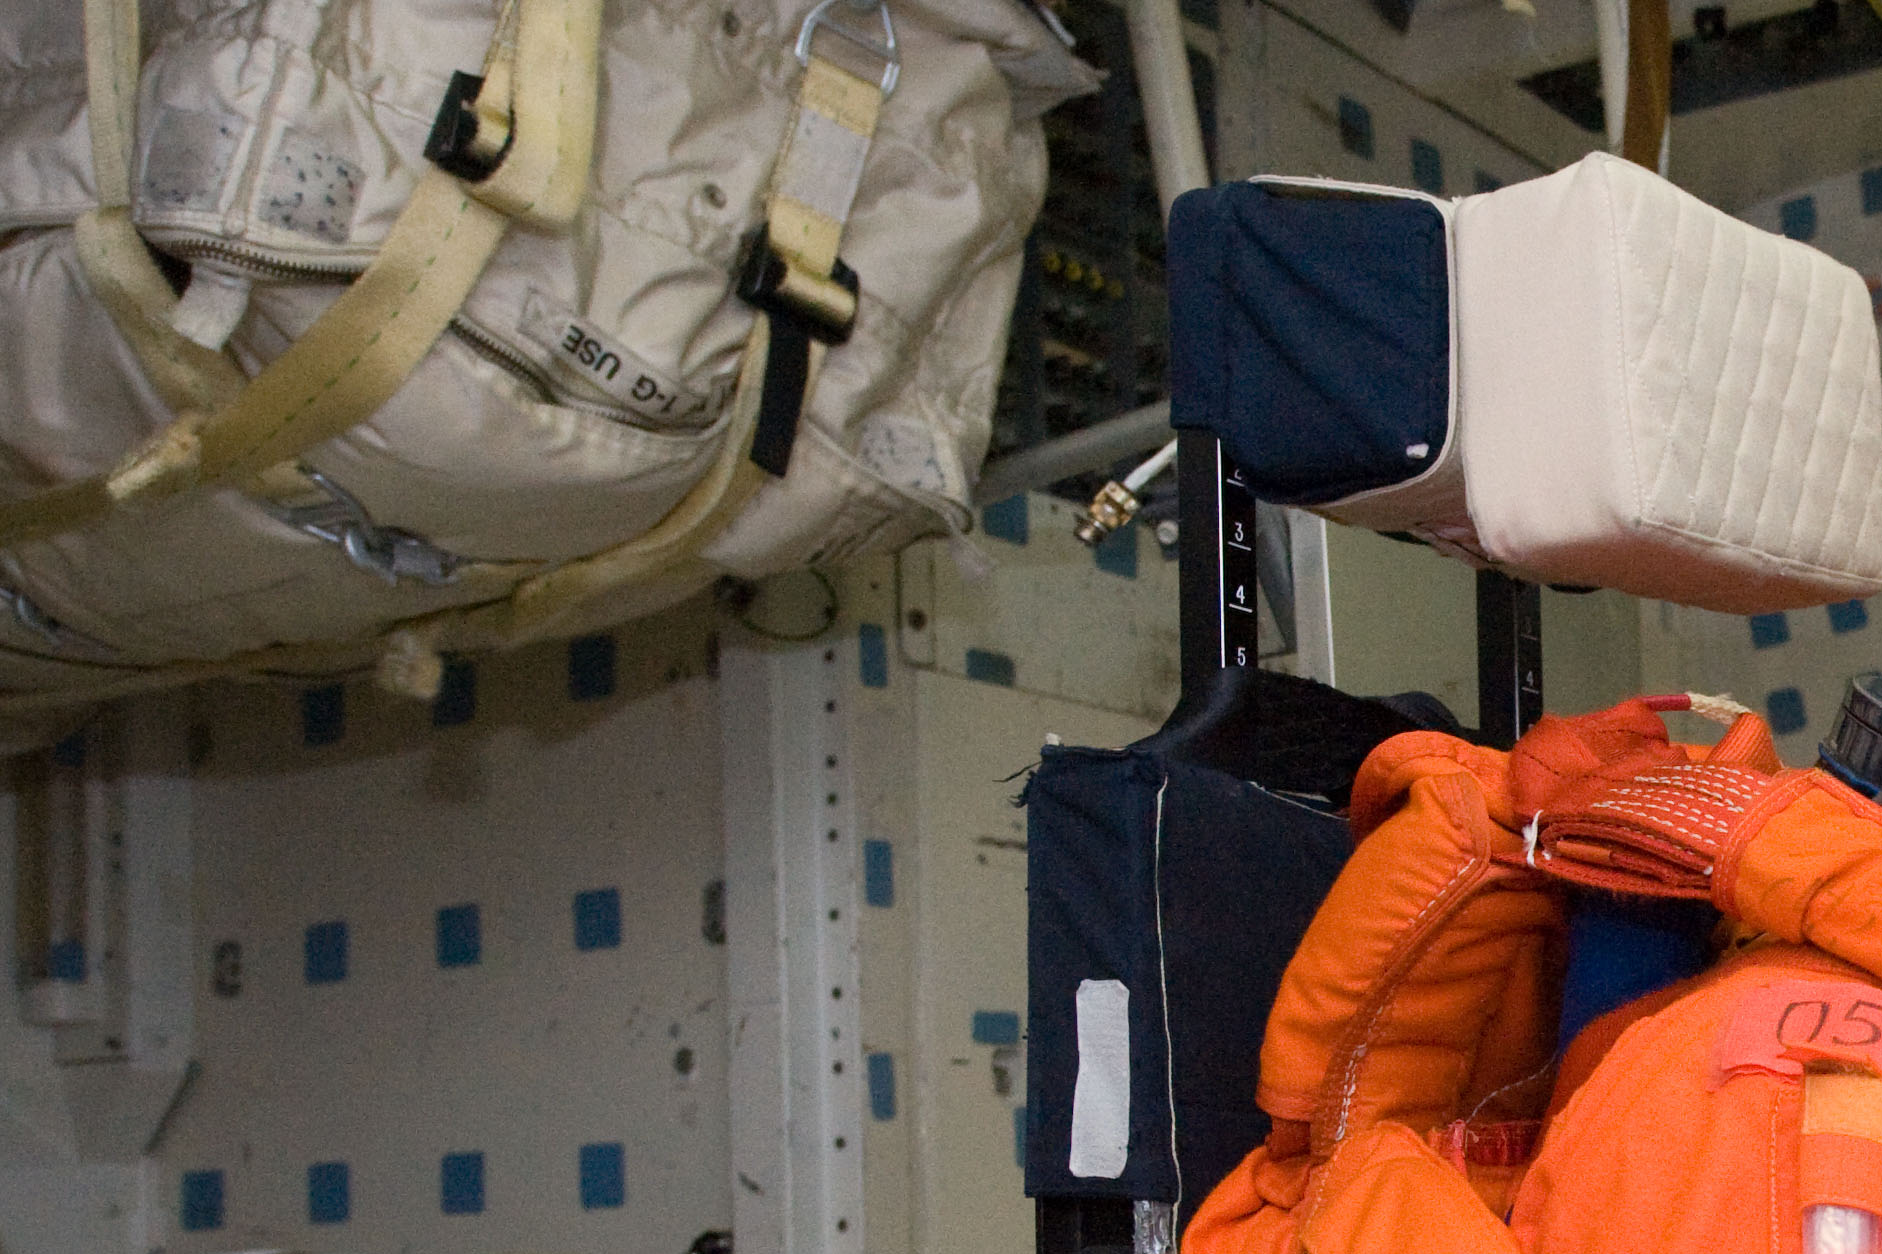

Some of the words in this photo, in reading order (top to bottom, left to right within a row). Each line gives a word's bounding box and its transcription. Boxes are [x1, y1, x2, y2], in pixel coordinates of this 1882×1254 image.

[562, 324, 621, 381] USE
[1235, 521, 1244, 542] 3
[1236, 584, 1246, 605] 4
[1236, 646, 1246, 666] 5
